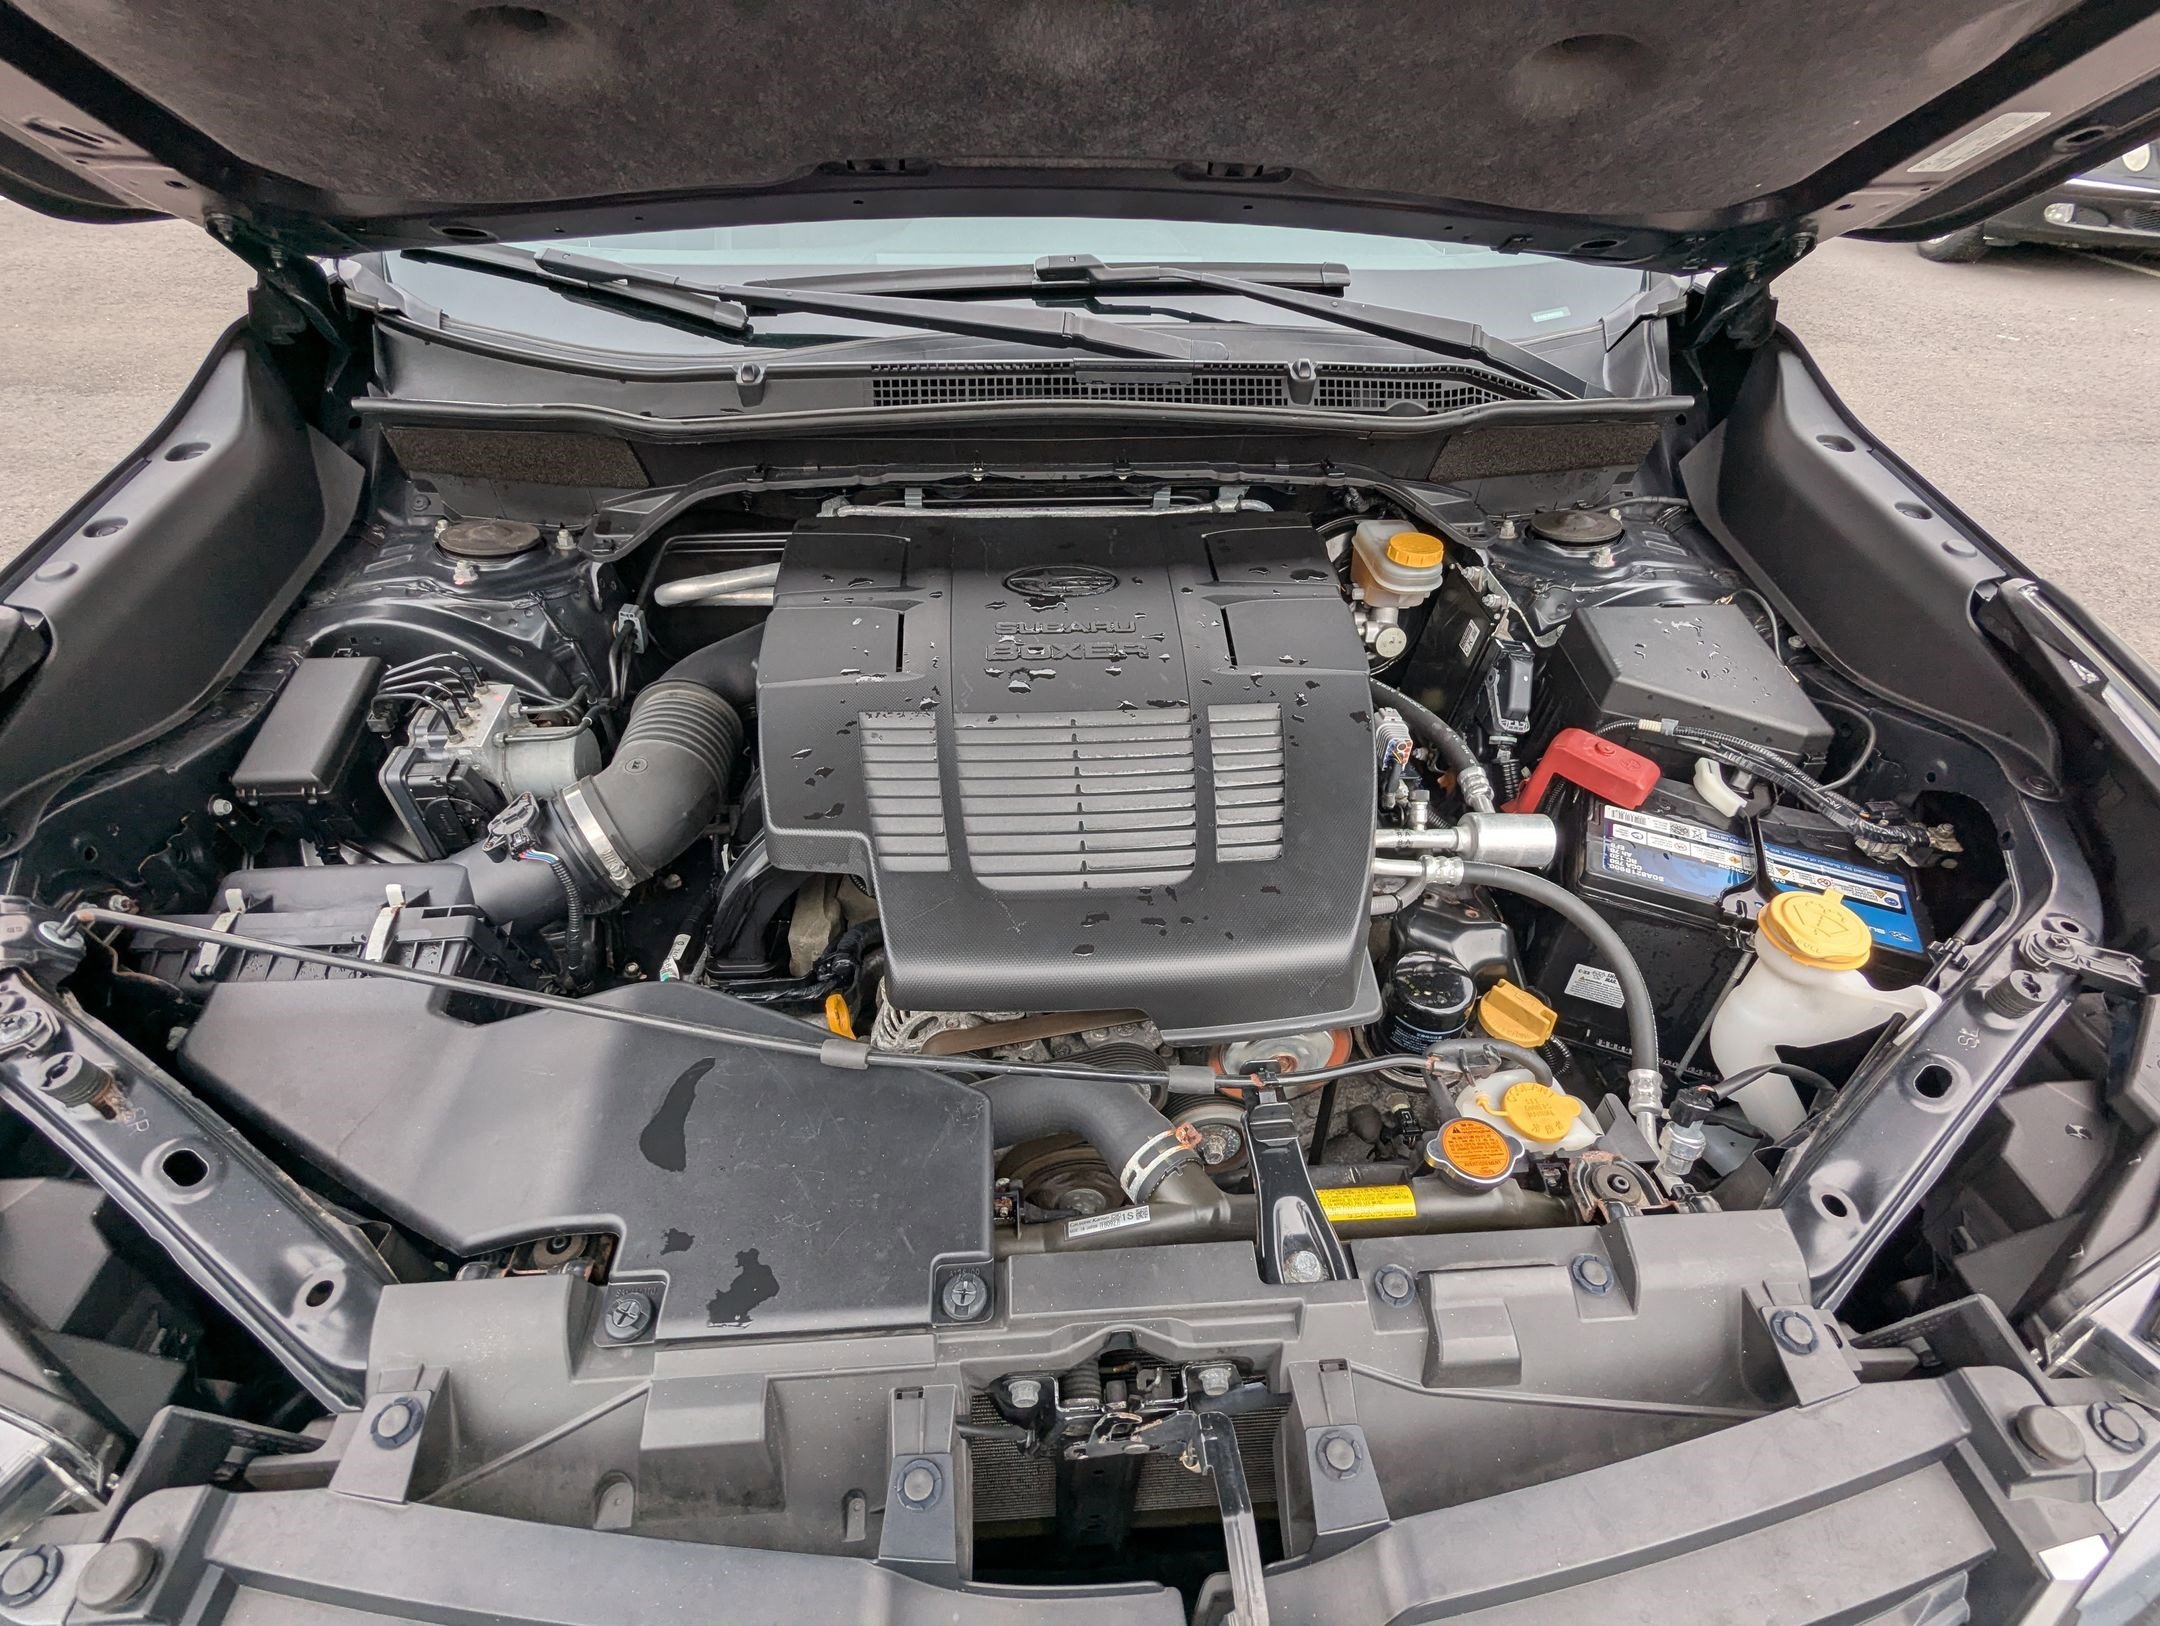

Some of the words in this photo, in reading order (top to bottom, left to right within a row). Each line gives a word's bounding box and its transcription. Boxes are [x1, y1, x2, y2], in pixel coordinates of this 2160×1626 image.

[995, 620, 1136, 635] SUBARU
[985, 642, 1150, 661] BOXER
[1608, 852, 1623, 860] 120
[1625, 856, 1637, 864] RC
[1624, 861, 1643, 871] CCA
[1817, 857, 1841, 868] Subaru
[1852, 866, 1889, 880] Distributed
